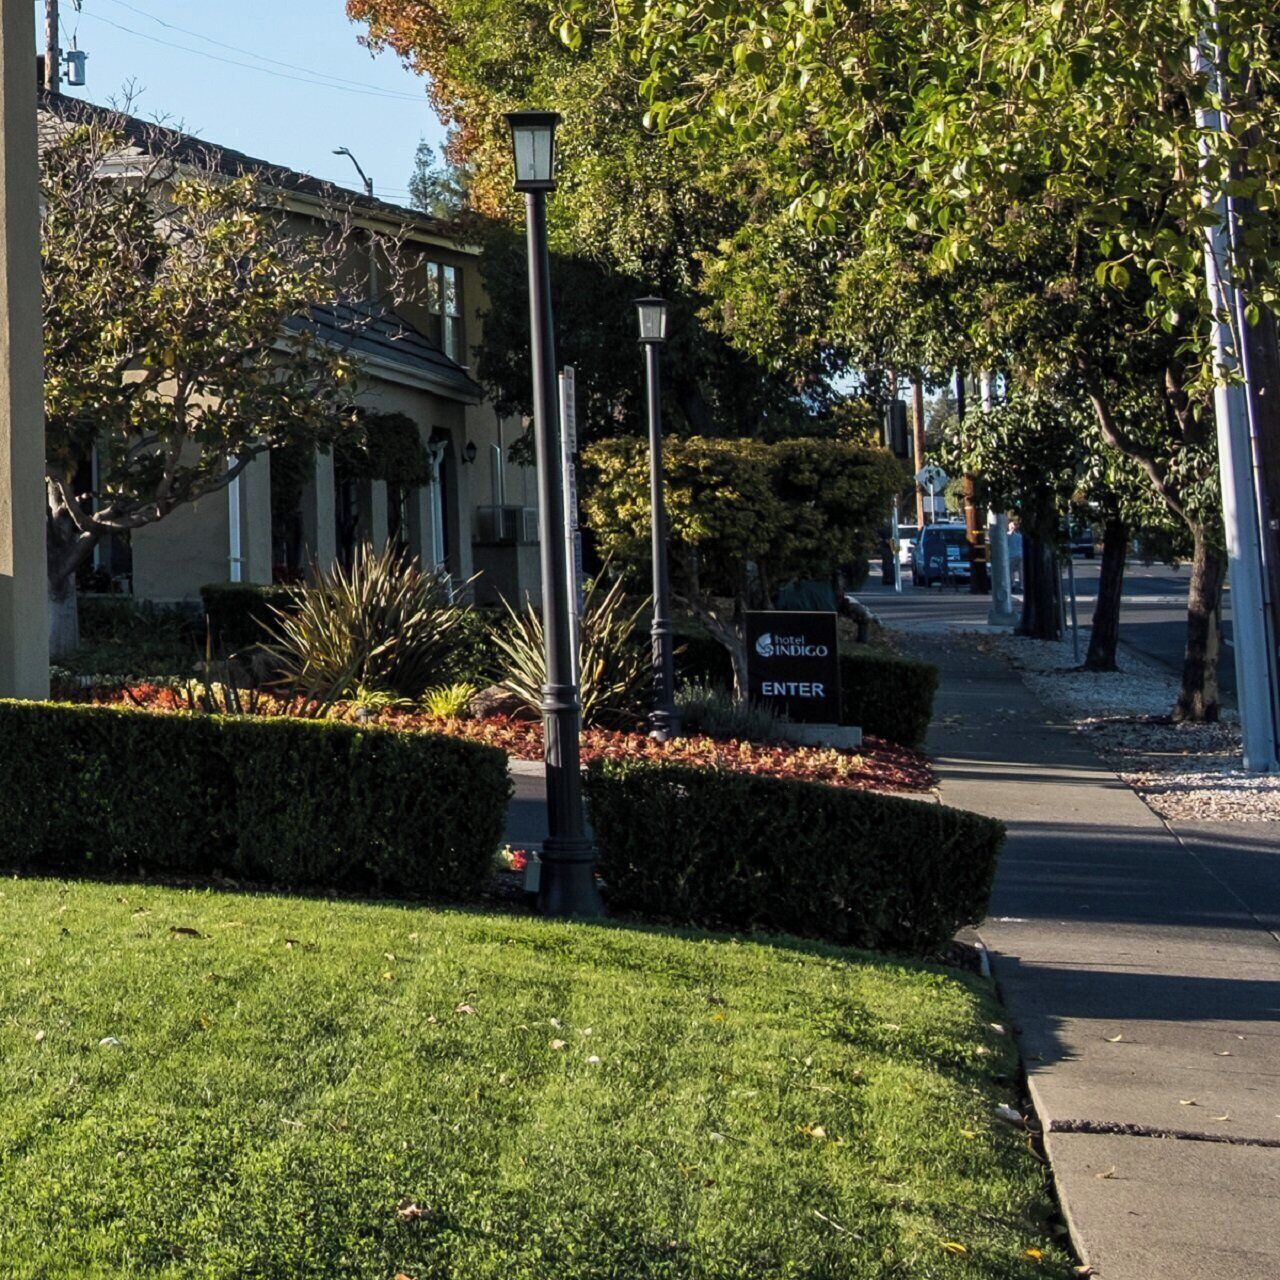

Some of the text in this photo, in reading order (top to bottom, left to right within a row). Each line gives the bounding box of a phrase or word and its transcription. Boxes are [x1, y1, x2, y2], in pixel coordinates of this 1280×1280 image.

[773, 634, 806, 645] hotel
[774, 645, 828, 657] INDIGO
[761, 681, 826, 697] ENTER
